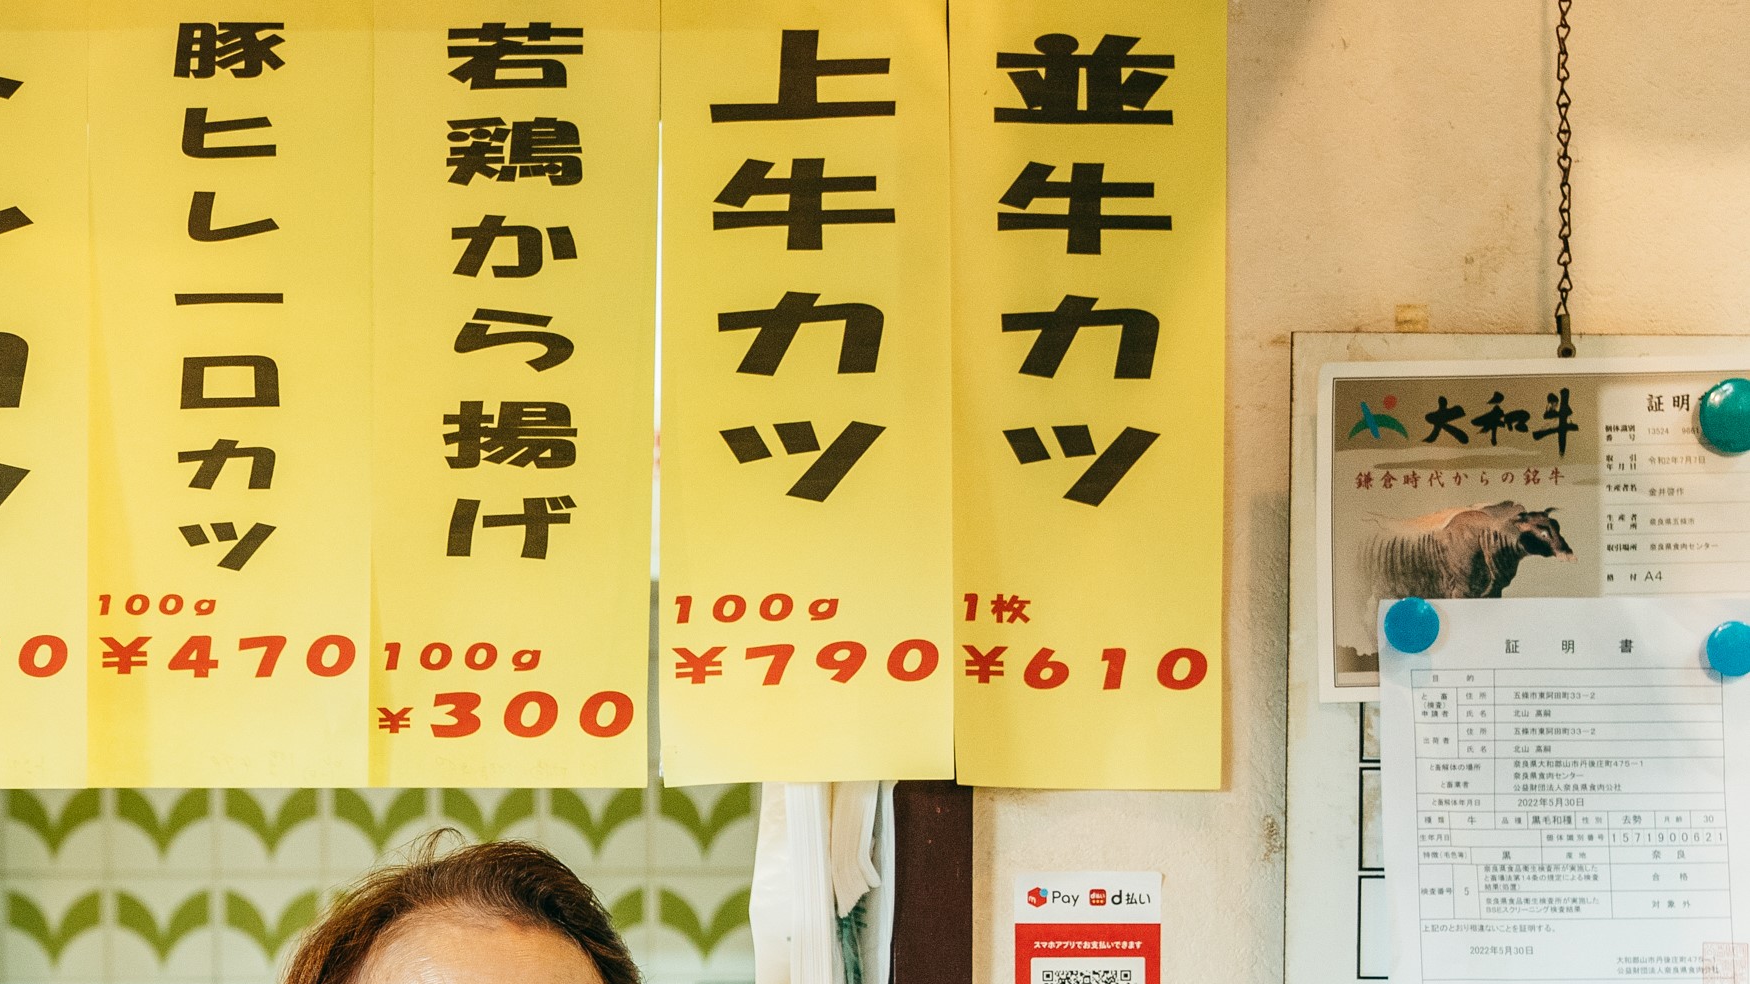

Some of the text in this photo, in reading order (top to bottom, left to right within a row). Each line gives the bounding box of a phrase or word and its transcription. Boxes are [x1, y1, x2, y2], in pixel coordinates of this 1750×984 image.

[710, 30, 896, 502] 上牛カツ
[994, 33, 1175, 507] 並牛カツ
[443, 22, 583, 559] 若鶏から揚げ
[1646, 393, 1706, 413] 証明
[1422, 388, 1579, 457] 大和牛
[1355, 468, 1565, 490] 鎌倉時代からの銘牛
[1644, 570, 1662, 582] A4
[99, 594, 216, 615] 100g
[676, 594, 838, 623] 100g
[1505, 638, 1635, 655] 証明書
[100, 635, 355, 677] ¥470
[385, 643, 541, 671] 100g
[674, 639, 938, 685] ¥790
[966, 647, 1207, 690] ¥610
[379, 691, 633, 737] ¥300
[1513, 771, 1584, 780] 奈良県食肉センター
[1517, 798, 1584, 807] 2022年5月30日
[1467, 815, 1477, 825] 牛
[1531, 815, 1572, 825] 黒毛和種
[1622, 815, 1642, 825] 去勢
[1703, 814, 1714, 823] 30
[1501, 850, 1512, 860] 黒
[1652, 849, 1686, 860] 奈良
[1652, 872, 1688, 881] 合格
[1052, 891, 1080, 906] Pay
[1111, 890, 1151, 905] d払い
[1464, 887, 1469, 896] 5
[1652, 900, 1691, 909] 対象外
[1422, 923, 1555, 933] 上記のとおり相違ないことを証明する。
[1033, 941, 1143, 950] スマホアプリでお支払いできます
[1470, 946, 1534, 955] 2022年5月30日
